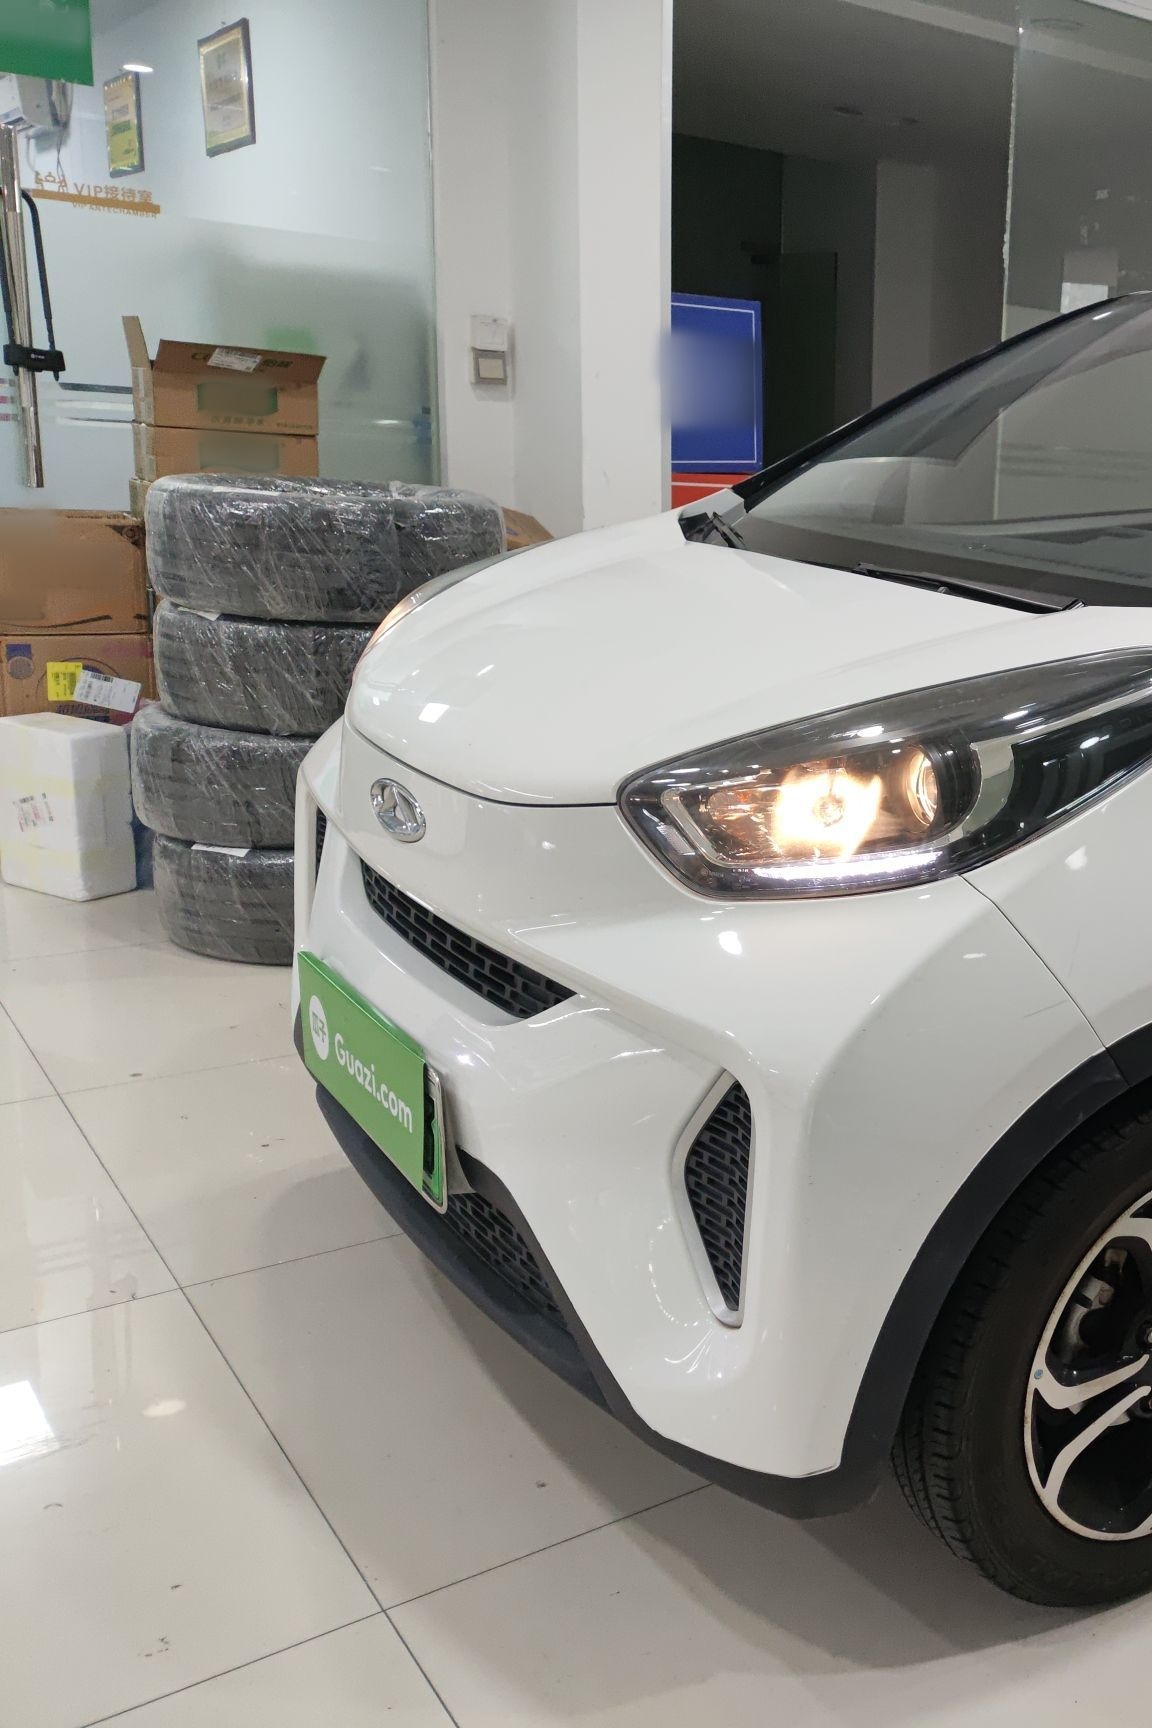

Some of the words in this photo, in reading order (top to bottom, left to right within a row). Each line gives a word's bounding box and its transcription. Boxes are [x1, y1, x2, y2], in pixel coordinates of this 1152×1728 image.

[74, 183, 153, 203] VIP接待室
[335, 1033, 413, 1133] Guazi.com
